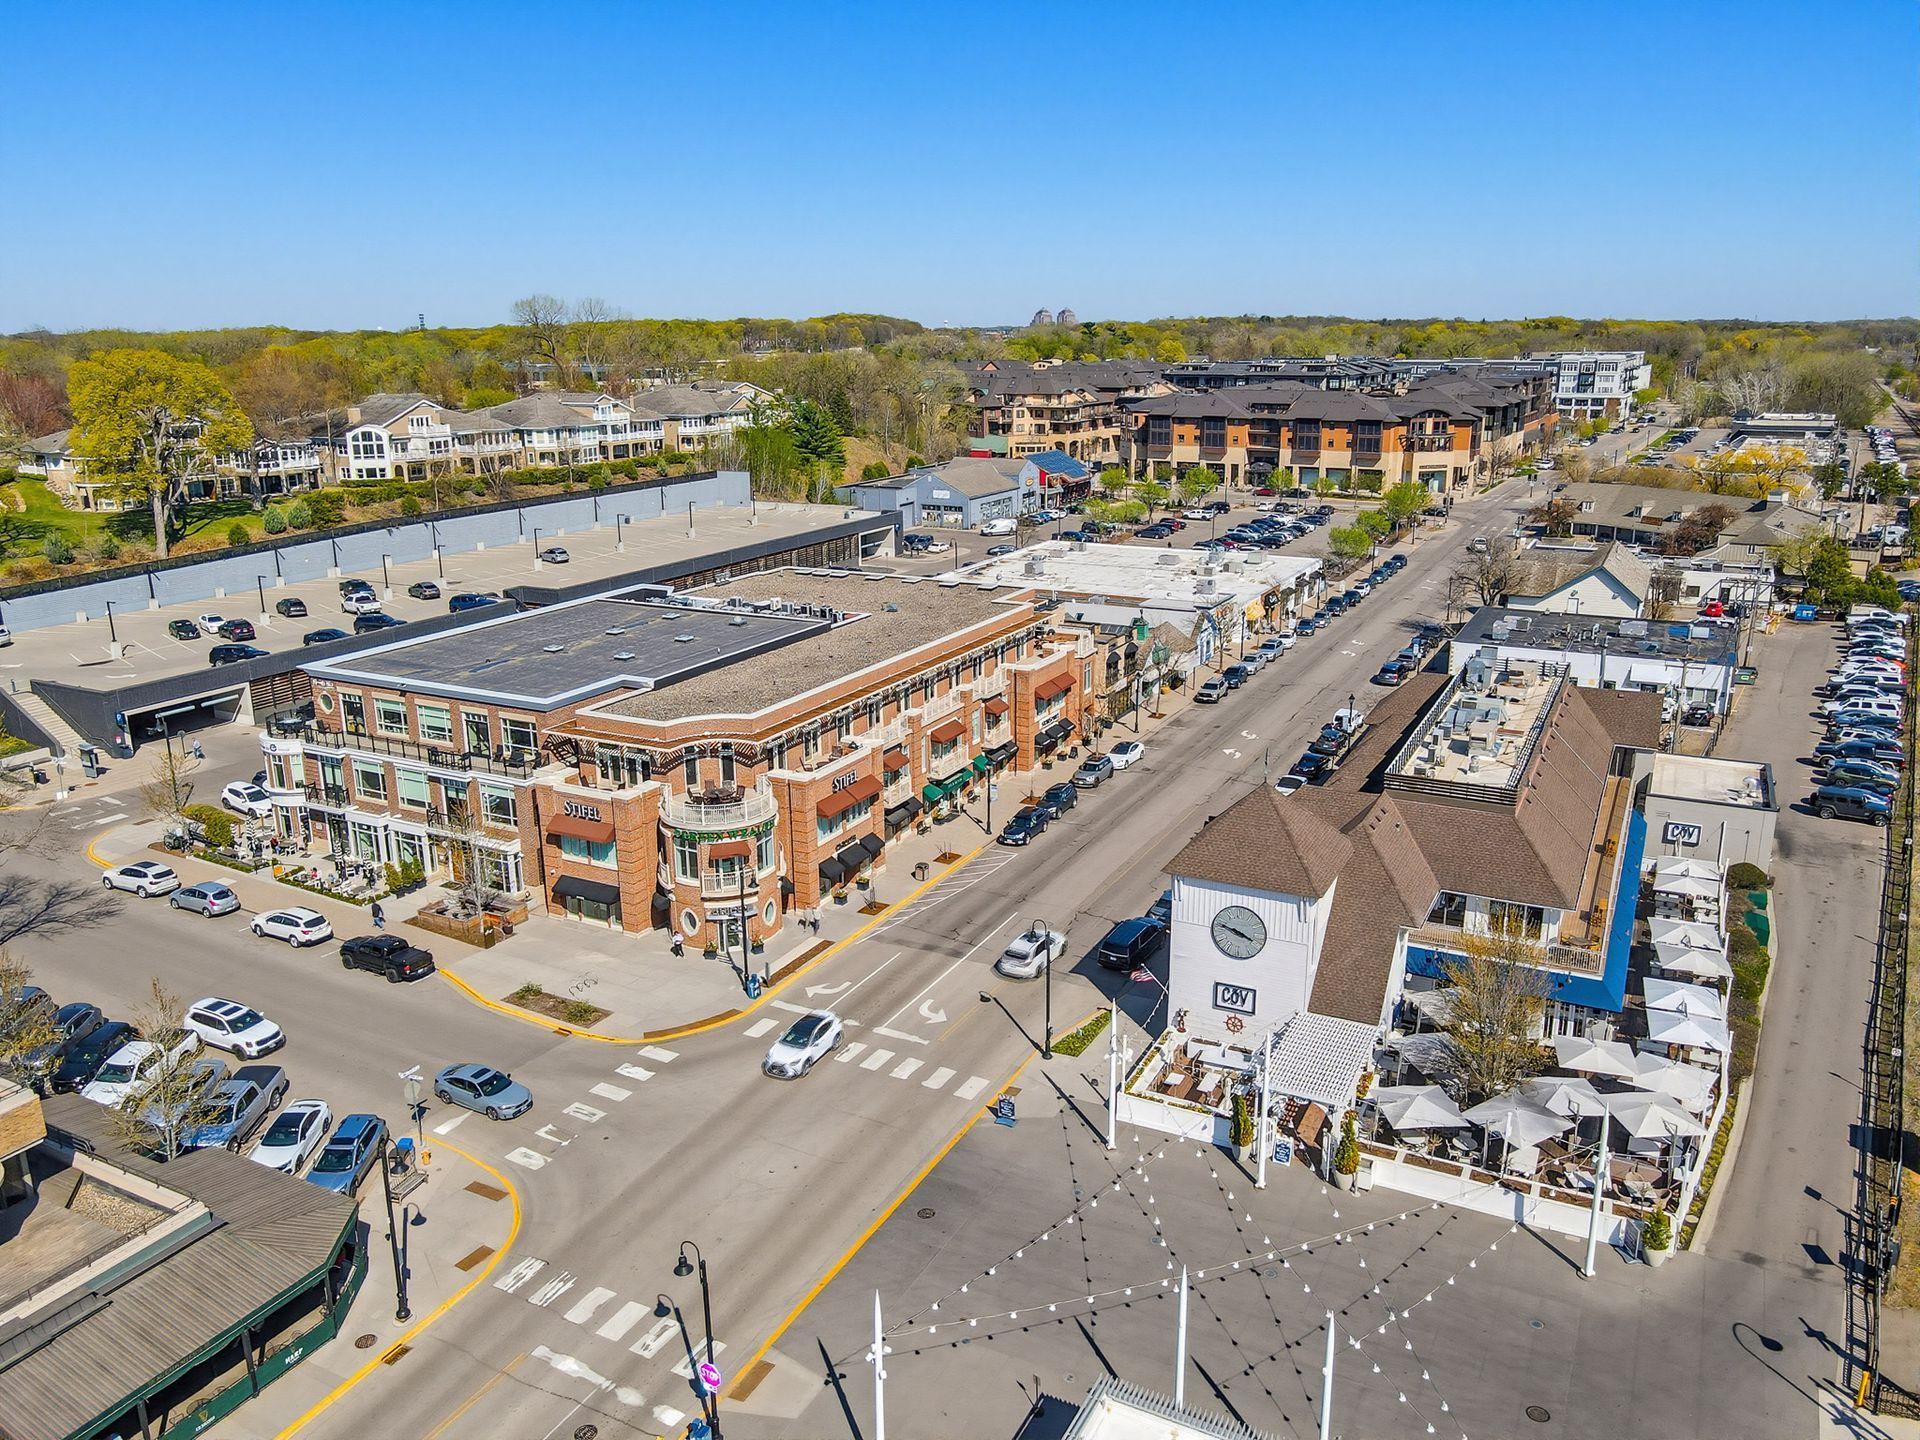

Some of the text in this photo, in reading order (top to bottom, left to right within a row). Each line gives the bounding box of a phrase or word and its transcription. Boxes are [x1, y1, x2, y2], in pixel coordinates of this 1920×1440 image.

[832, 769, 858, 791] STIFEL
[564, 800, 602, 820] STIFEL
[701, 1367, 719, 1381] STOP
